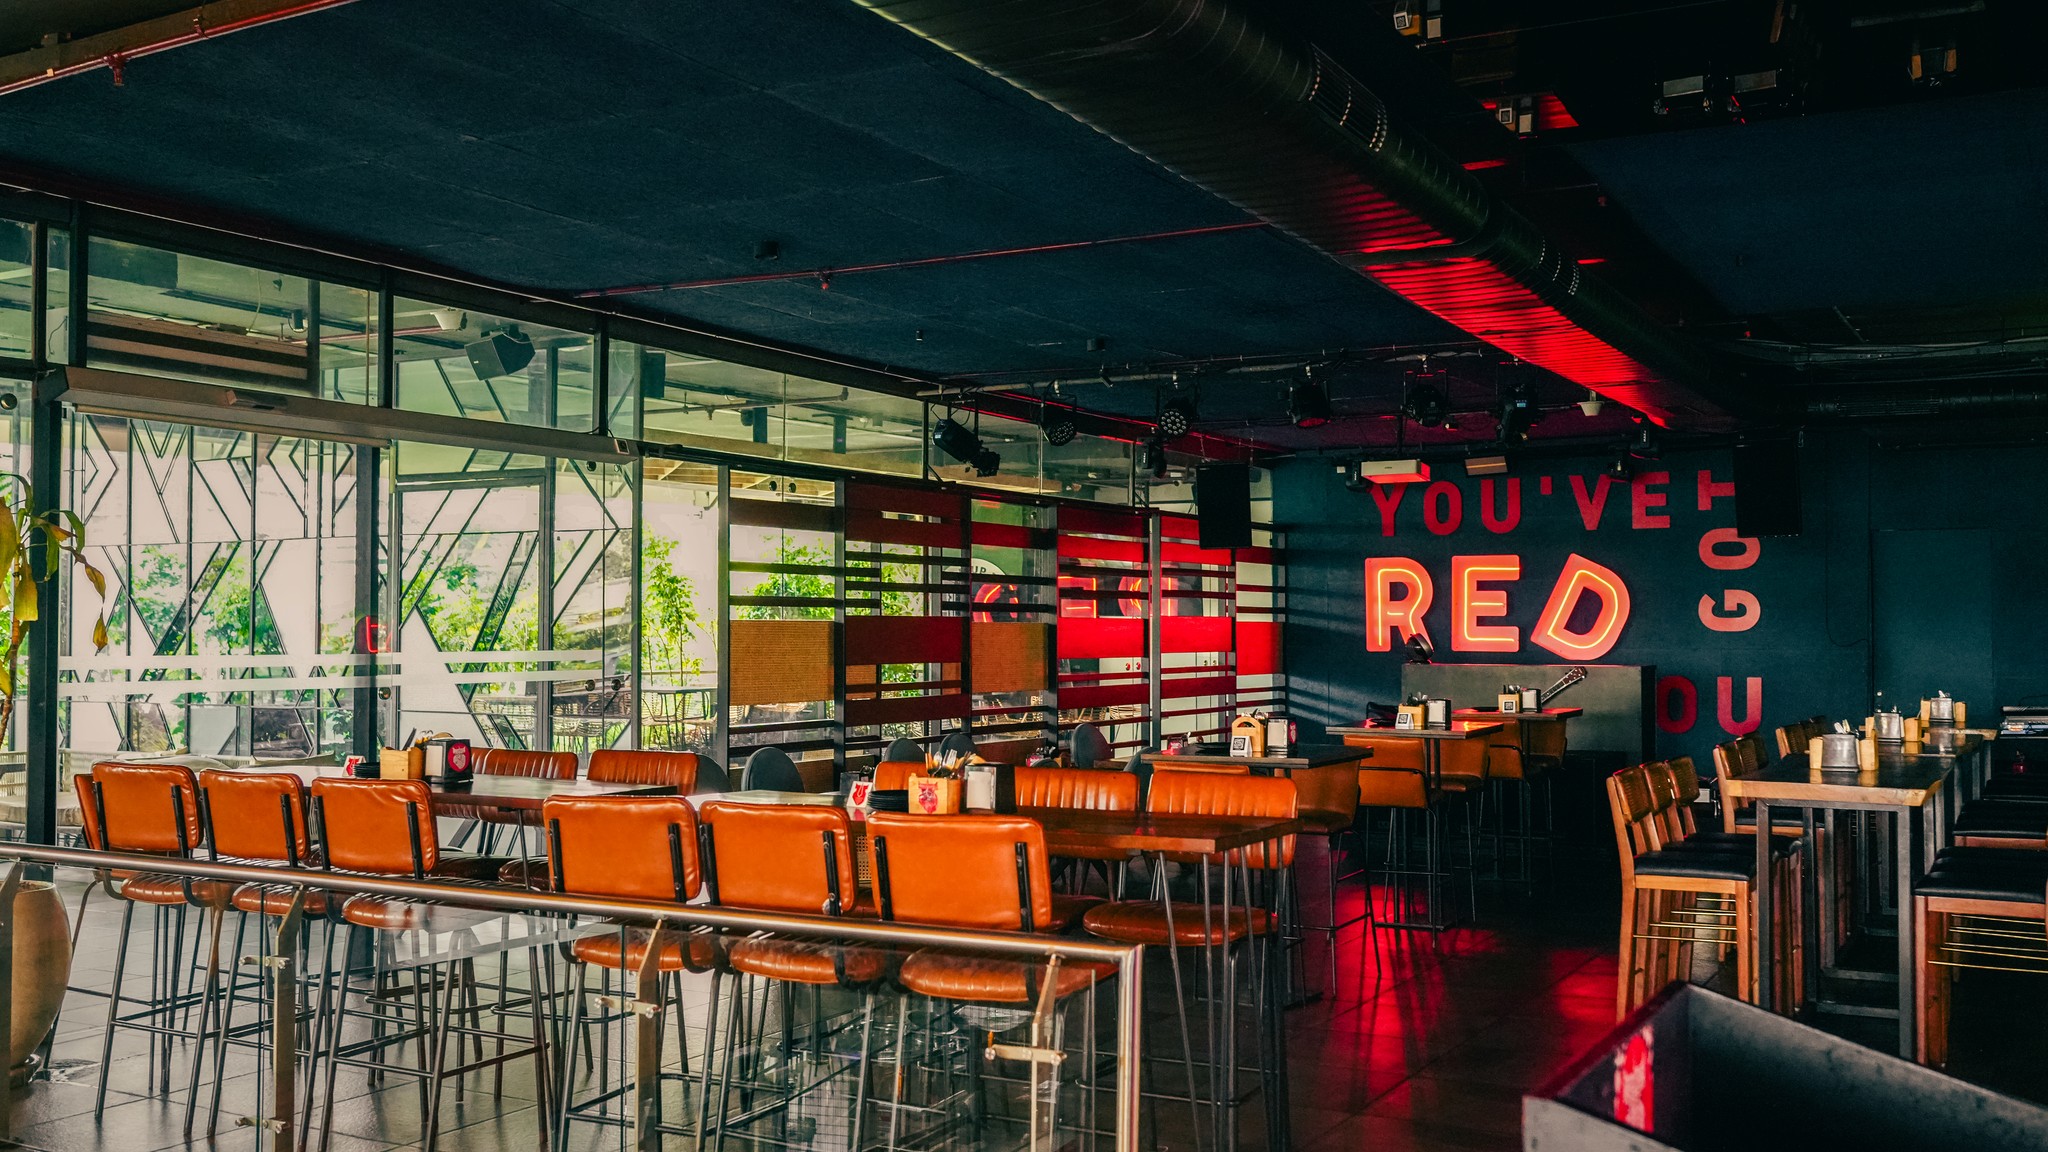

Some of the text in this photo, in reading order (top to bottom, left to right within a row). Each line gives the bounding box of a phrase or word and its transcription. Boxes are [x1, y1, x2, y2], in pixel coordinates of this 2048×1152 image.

[1370, 471, 1670, 537] YOU'VE
[1698, 470, 1761, 631] GOT
[1365, 553, 1630, 660] RED
[1657, 676, 1762, 735] OU
